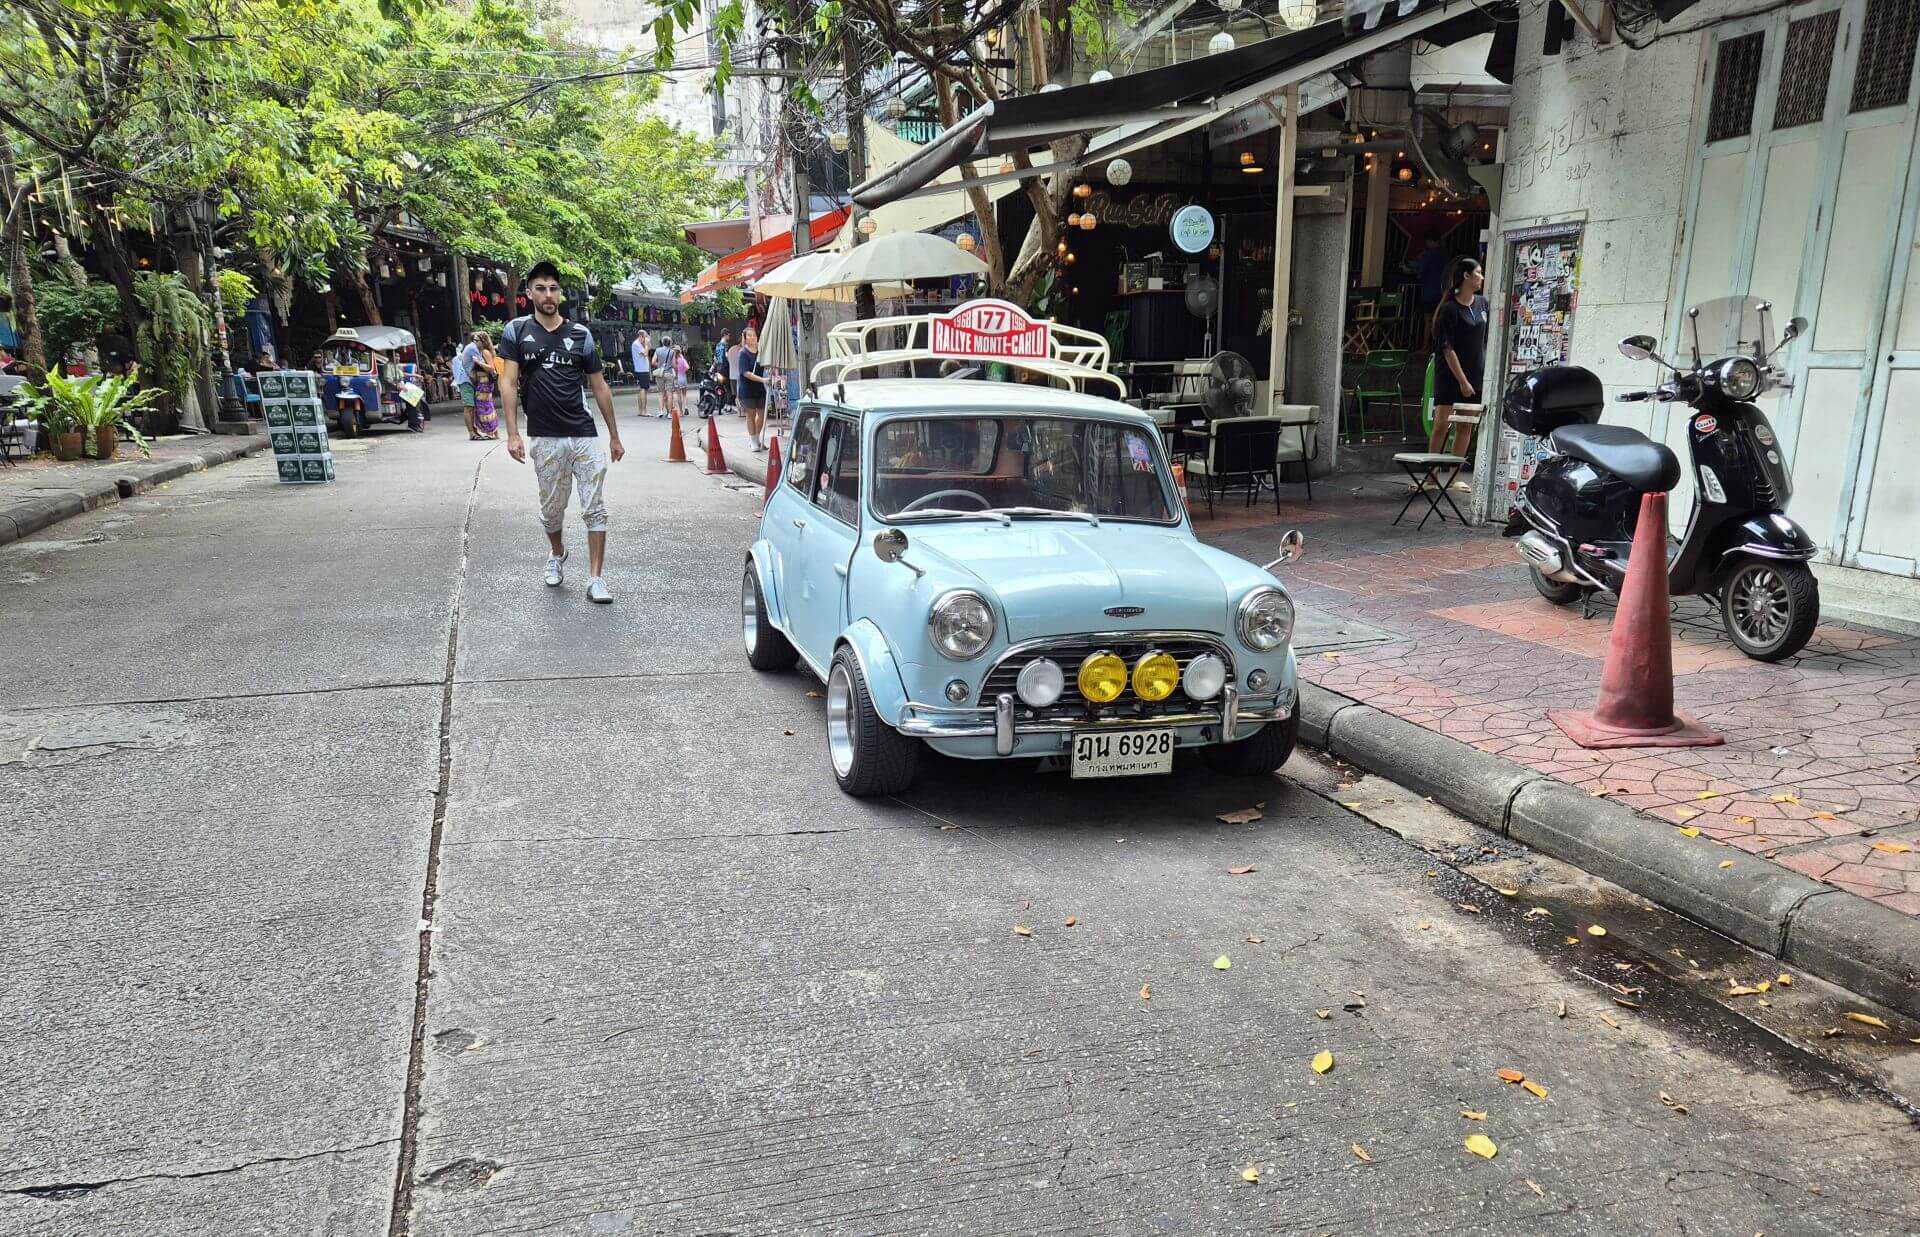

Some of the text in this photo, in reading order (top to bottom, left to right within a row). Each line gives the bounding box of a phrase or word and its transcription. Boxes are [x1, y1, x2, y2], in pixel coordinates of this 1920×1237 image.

[977, 311, 1006, 330] 177
[935, 320, 1044, 355] RALLYE MONTE-CARLO
[1119, 732, 1170, 756] 6928
[1088, 761, 1158, 773] กรุงเทพมหานคร
